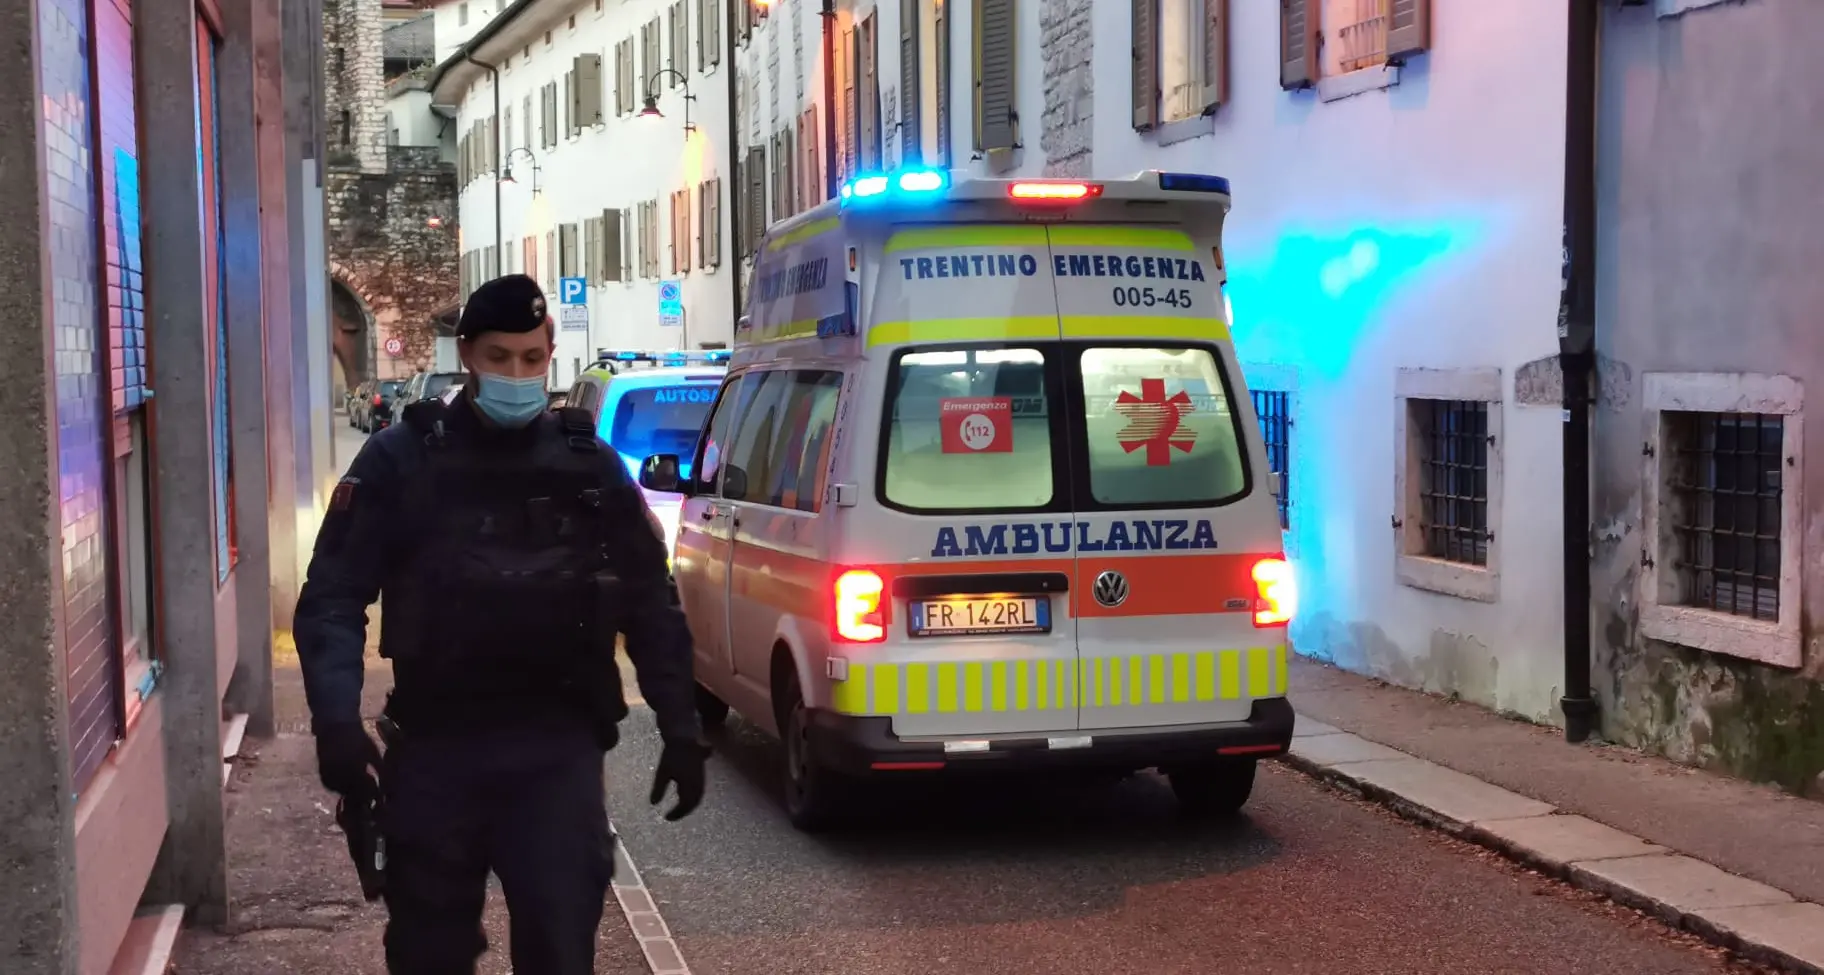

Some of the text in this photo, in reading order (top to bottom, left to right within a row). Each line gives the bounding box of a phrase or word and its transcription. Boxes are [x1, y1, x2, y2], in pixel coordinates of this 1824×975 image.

[900, 254, 1205, 282] TRENTINO EMERGENZA
[564, 279, 582, 303] P
[1113, 286, 1192, 308] 005-45
[943, 401, 1008, 412] Emergenza
[971, 426, 989, 437] 112
[931, 519, 1218, 557] AMBULANZA
[926, 601, 1035, 627] FR 142RL
